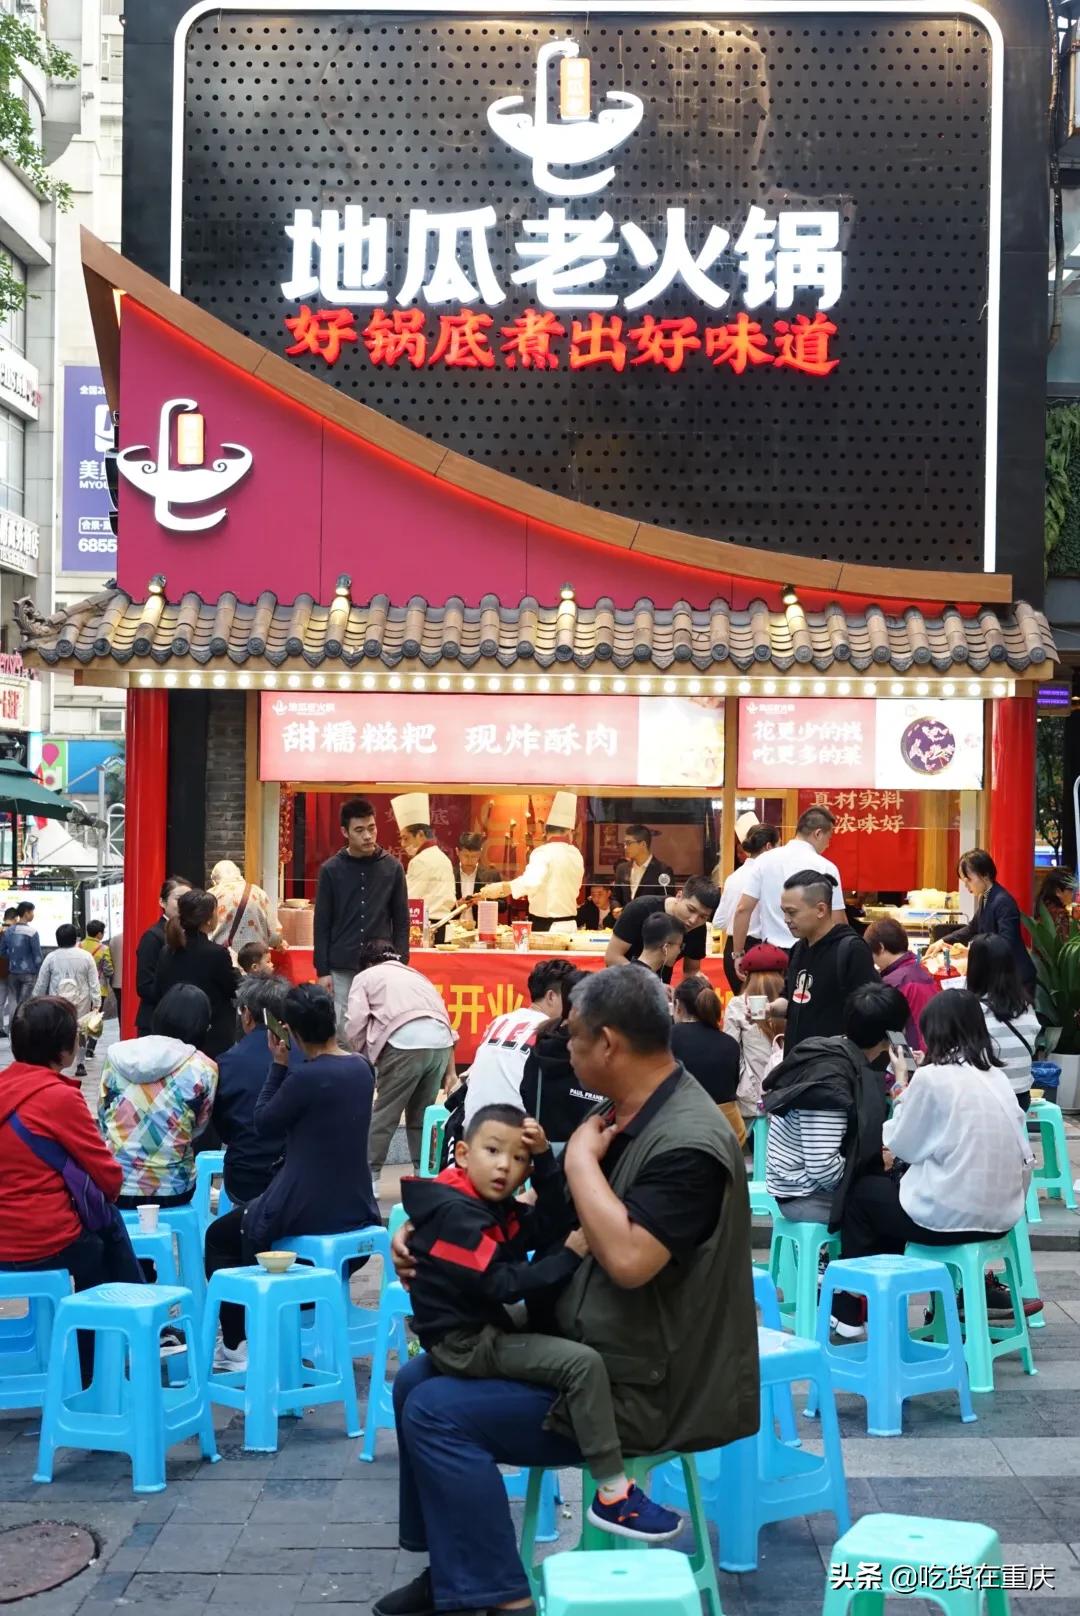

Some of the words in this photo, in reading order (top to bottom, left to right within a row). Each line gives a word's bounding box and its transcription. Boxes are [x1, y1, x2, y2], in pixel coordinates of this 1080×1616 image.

[281, 204, 844, 311] 地瓜老火锅
[285, 307, 840, 375] 好锅底煮出好味道
[281, 720, 437, 754] 甜糯糍粑
[464, 723, 618, 757] 现炸酥肉
[752, 720, 863, 742] 花更少的钱
[752, 745, 863, 766] 吃更多的菜
[810, 789, 904, 811] 真材实料
[569, 1088, 584, 1097] PAUL
